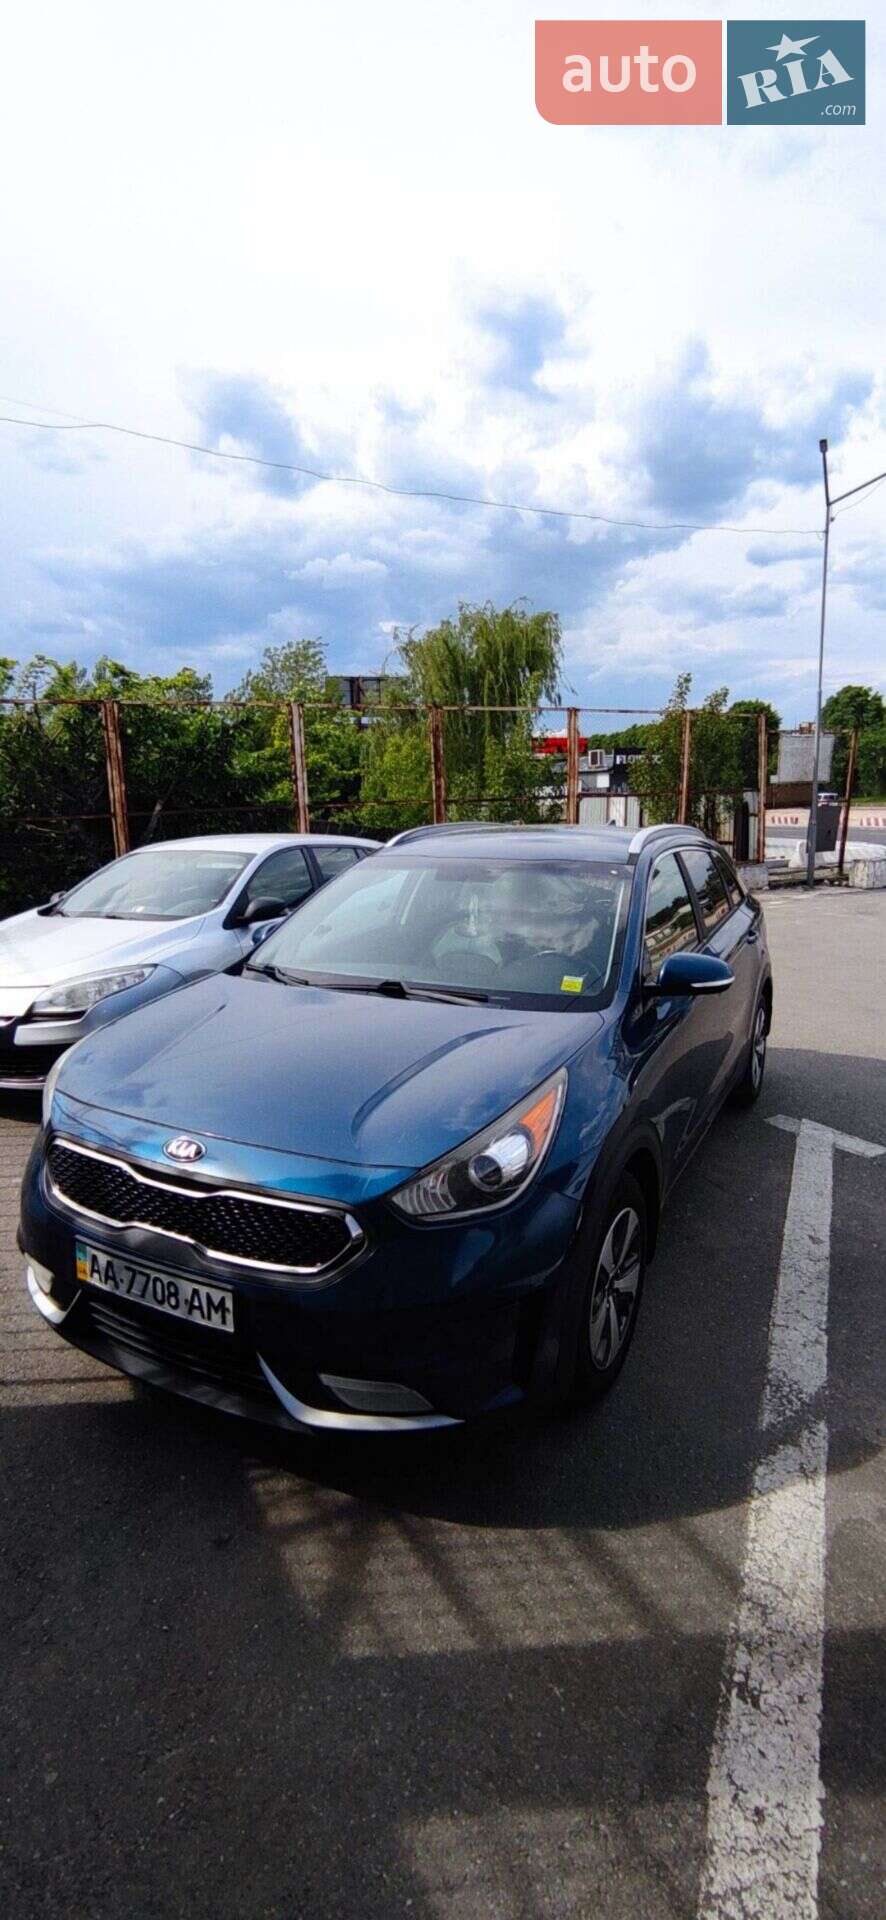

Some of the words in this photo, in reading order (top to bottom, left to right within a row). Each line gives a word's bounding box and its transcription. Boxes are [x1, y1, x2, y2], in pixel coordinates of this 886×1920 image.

[167, 1140, 198, 1158] KIA
[90, 1253, 120, 1290] AA
[124, 1265, 180, 1310] 7708
[187, 1287, 227, 1325] AM
